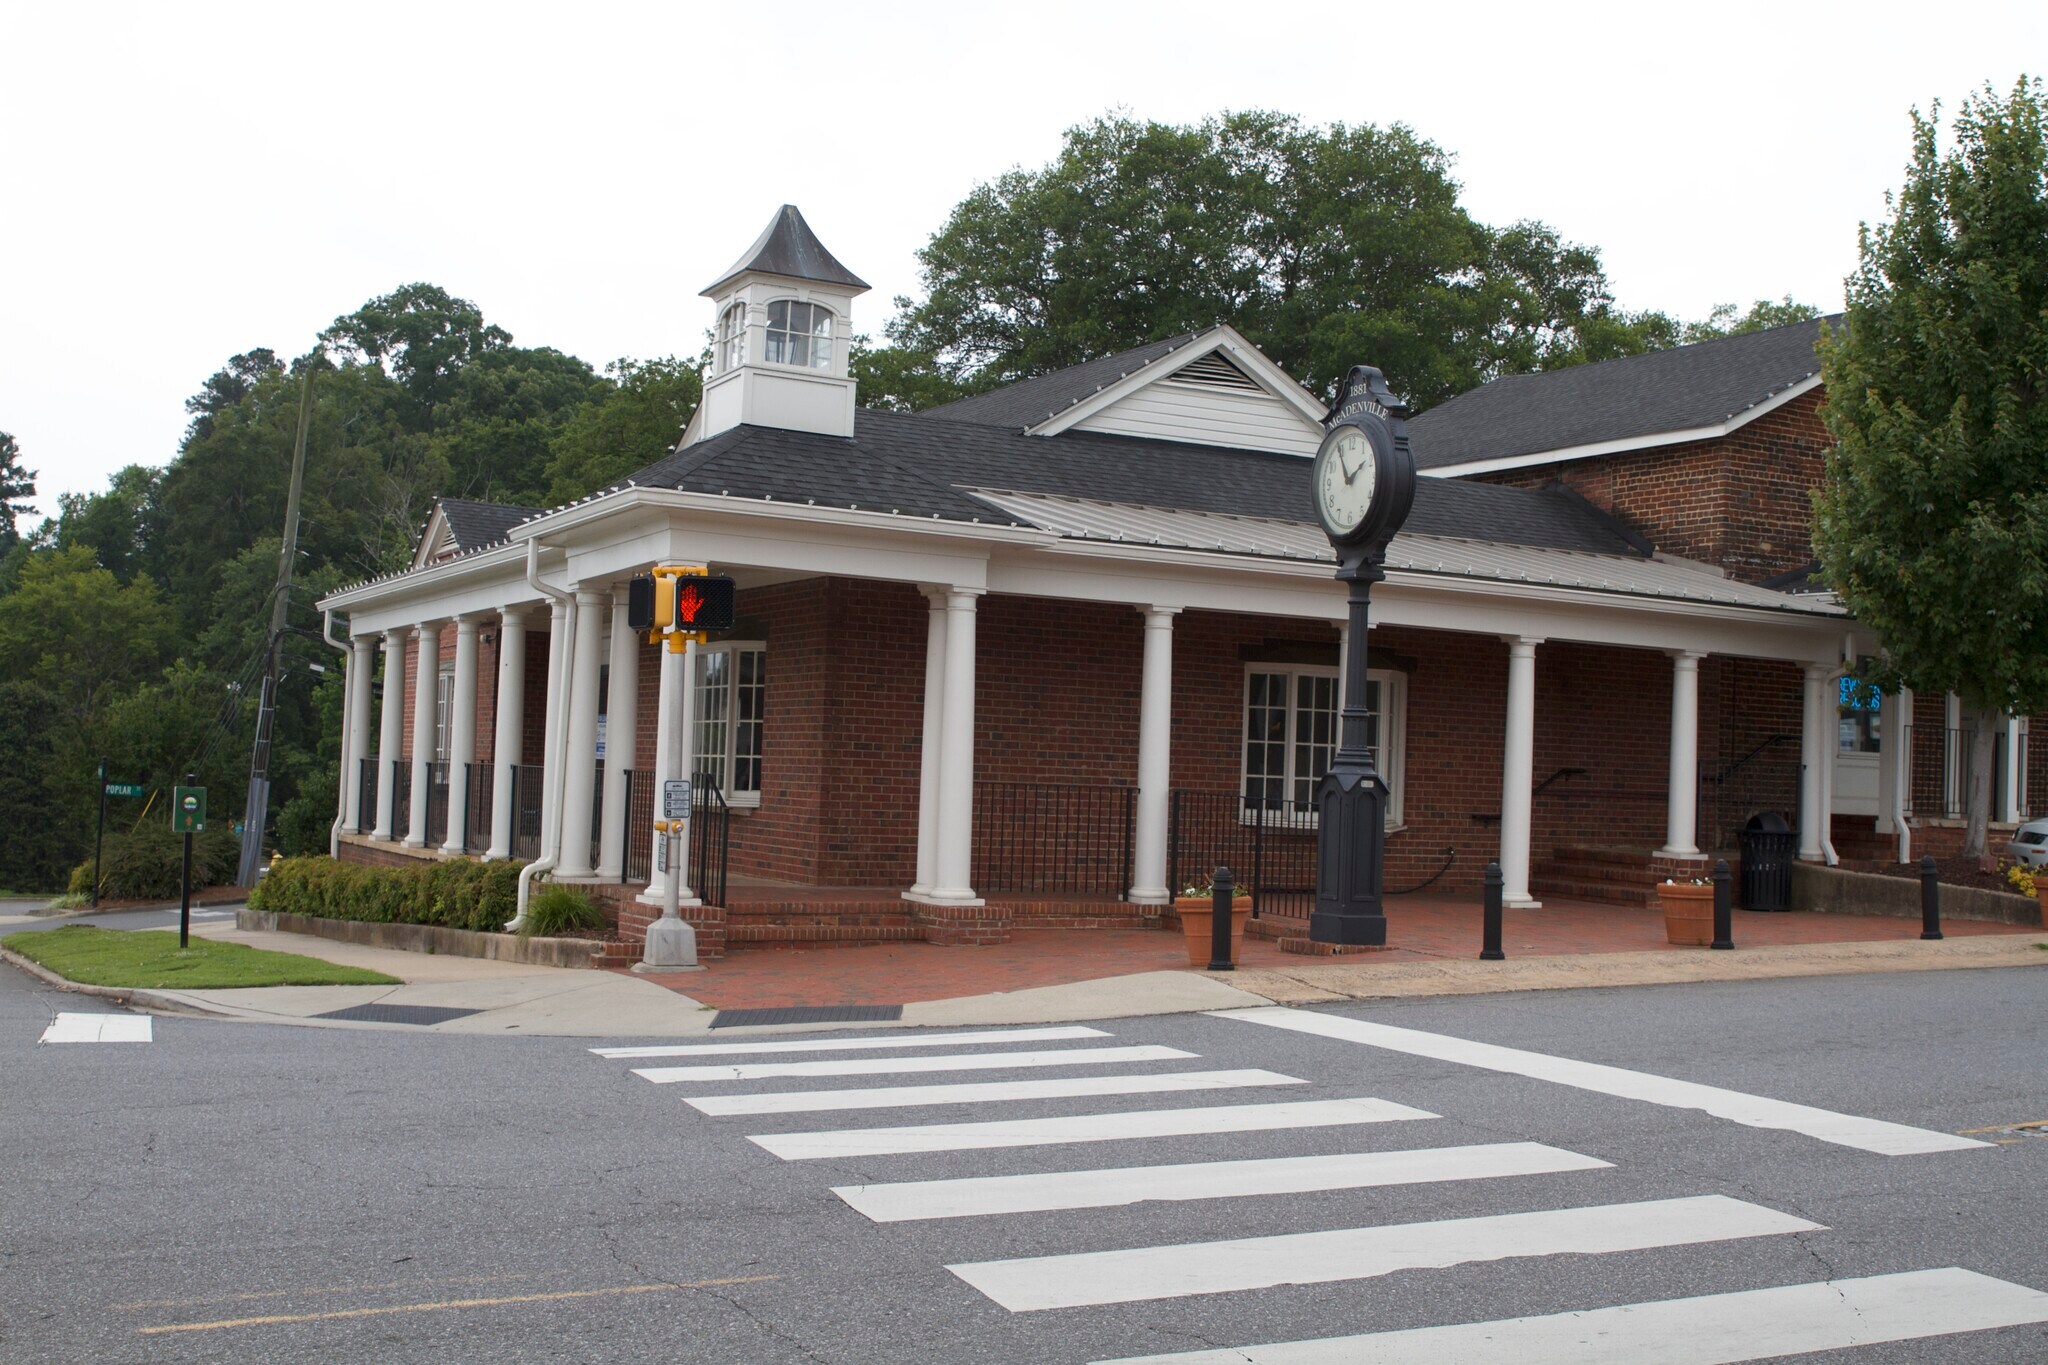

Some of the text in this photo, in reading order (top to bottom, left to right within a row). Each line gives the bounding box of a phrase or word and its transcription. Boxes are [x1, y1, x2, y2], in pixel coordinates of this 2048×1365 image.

[1350, 383, 1367, 397] 1881
[1328, 494, 1335, 509] 8
[105, 784, 132, 795] POPLAR
